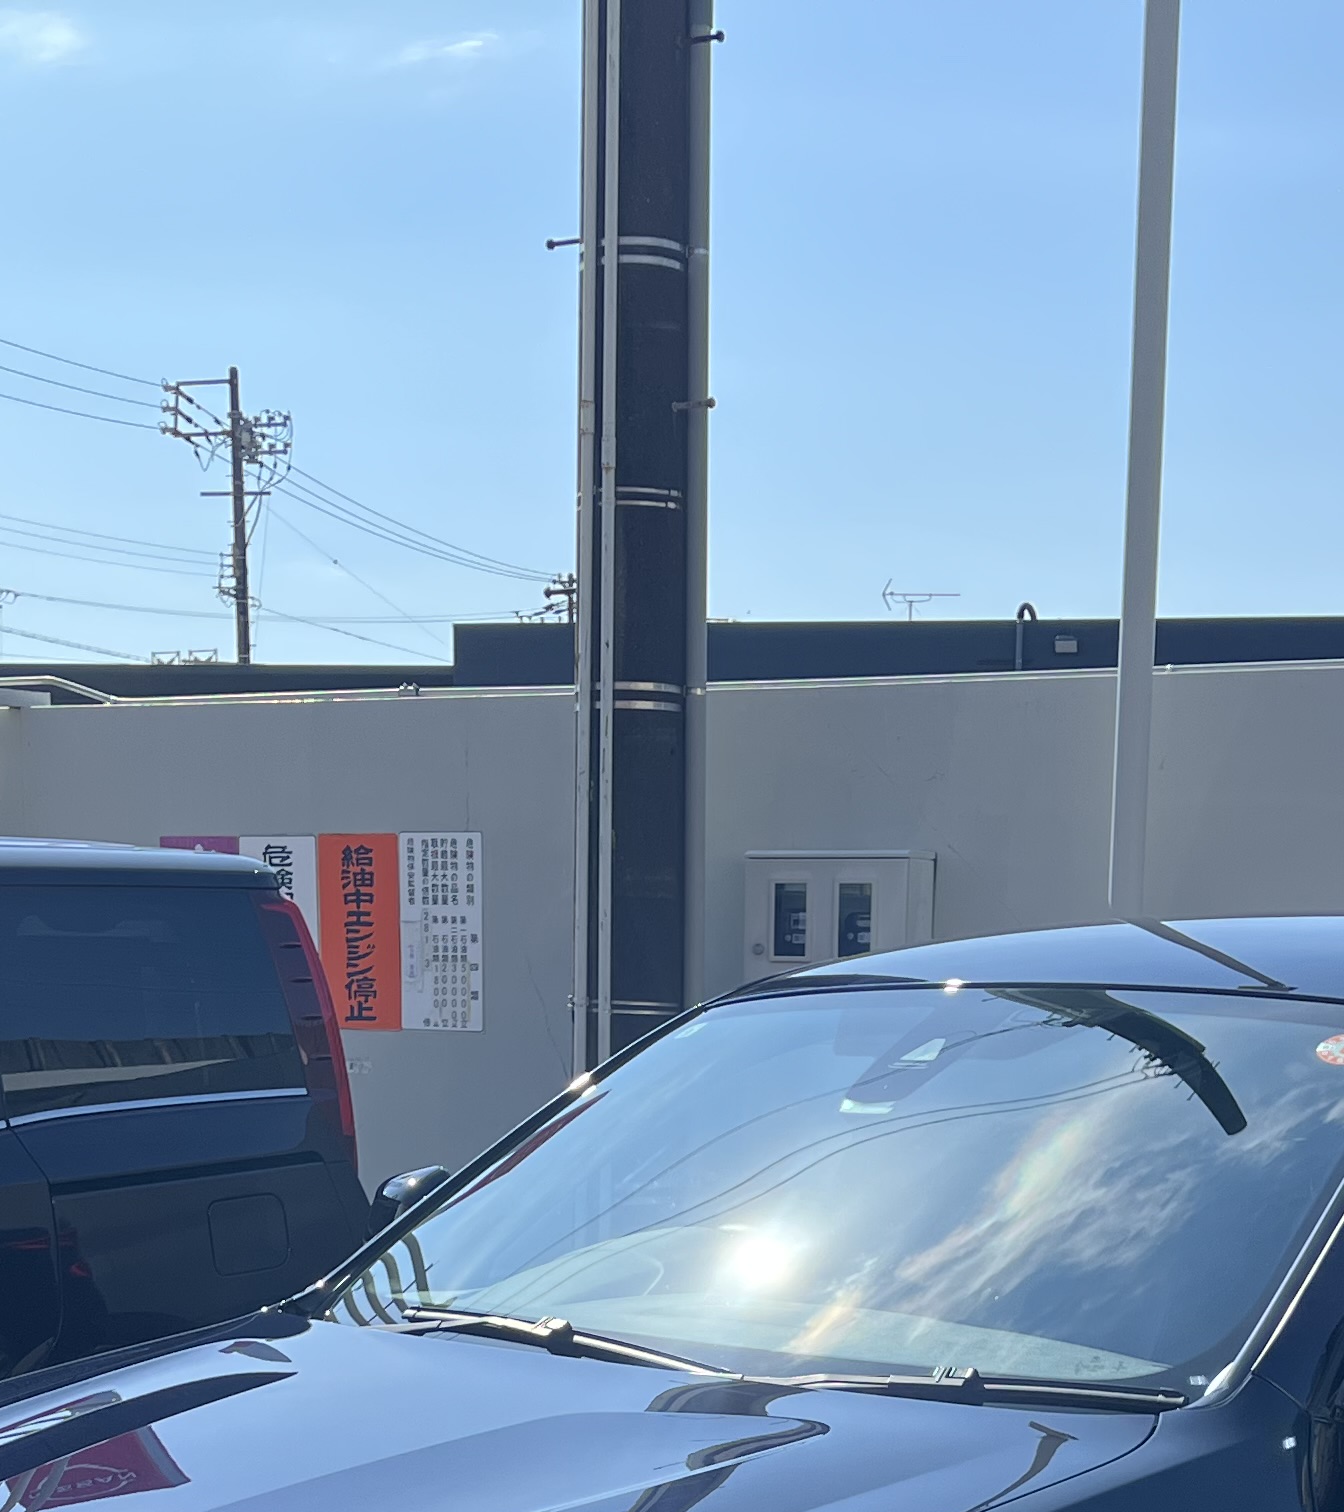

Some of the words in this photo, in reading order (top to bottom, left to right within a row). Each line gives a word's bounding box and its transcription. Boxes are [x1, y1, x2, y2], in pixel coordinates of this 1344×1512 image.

[341, 844, 378, 1023] 給油中エンジン停止
